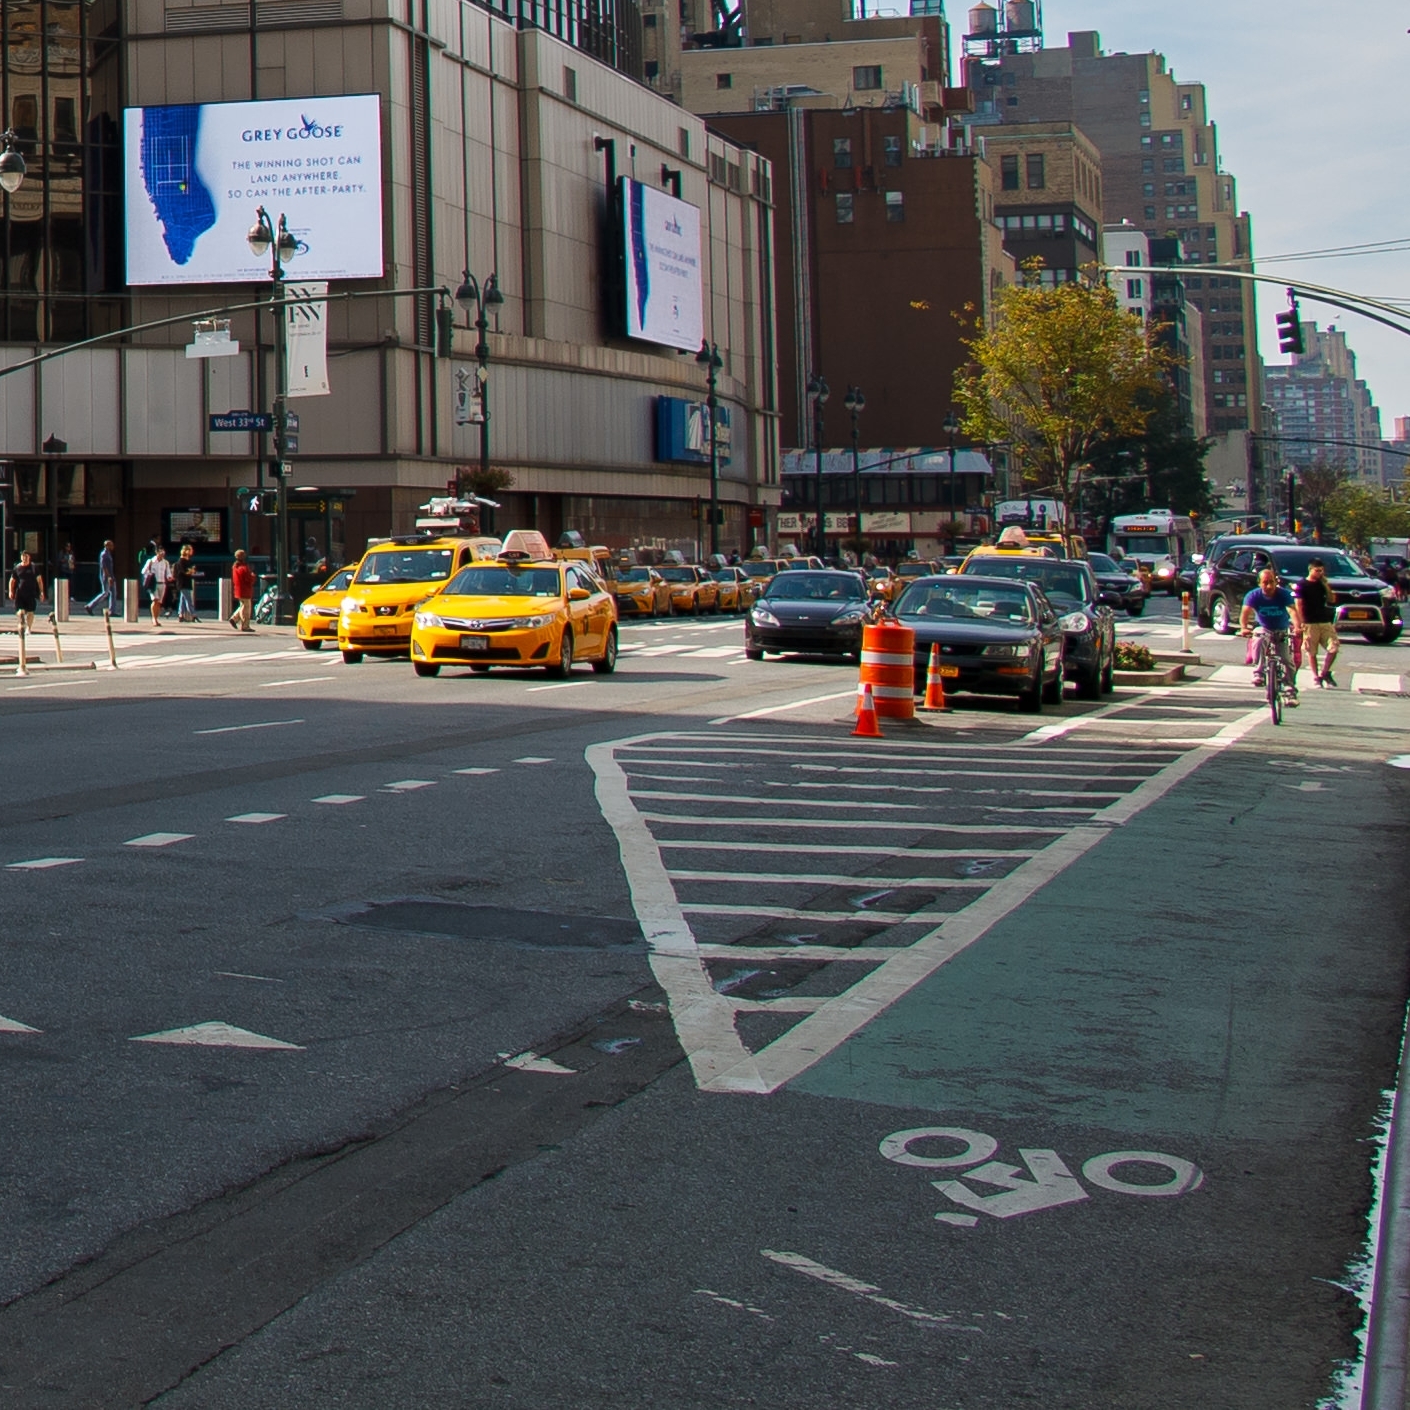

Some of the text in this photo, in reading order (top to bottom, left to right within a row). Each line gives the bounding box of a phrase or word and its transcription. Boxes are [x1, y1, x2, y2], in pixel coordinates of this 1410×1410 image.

[241, 123, 341, 144] GREY GOOSE
[232, 154, 361, 170] THE WINNING SHOT CAN
[250, 170, 342, 184] LAND ANYWHERE.
[227, 183, 366, 199] SO CAN THE AFTER-PARTY.
[214, 417, 265, 428] West 33rd St
